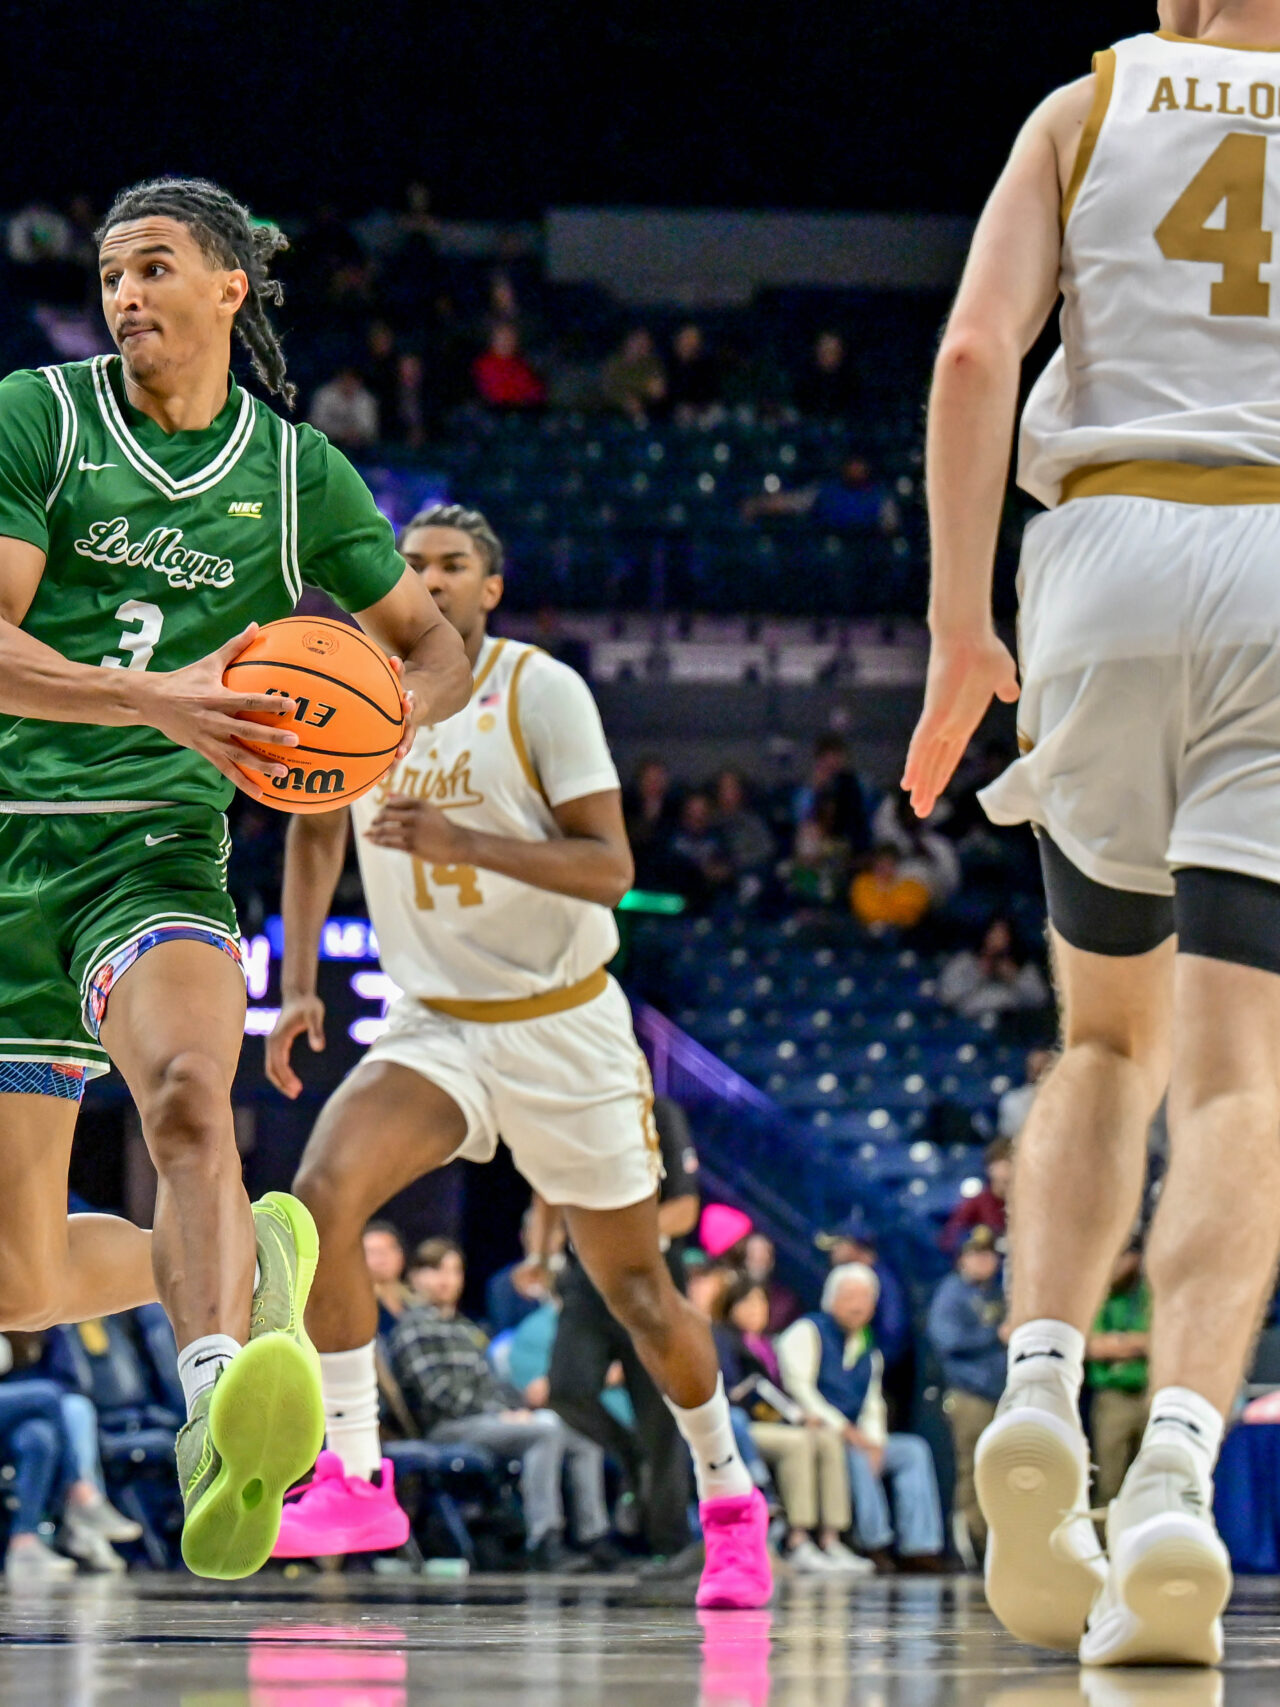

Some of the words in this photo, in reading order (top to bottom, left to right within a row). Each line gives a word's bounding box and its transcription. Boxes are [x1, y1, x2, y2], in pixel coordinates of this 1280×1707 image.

[1147, 76, 1280, 120] ALLO
[1154, 132, 1273, 317] 4
[228, 502, 263, 515] NEC
[100, 599, 164, 671] 3
[264, 766, 345, 794] Wil
[411, 853, 484, 911] 14
